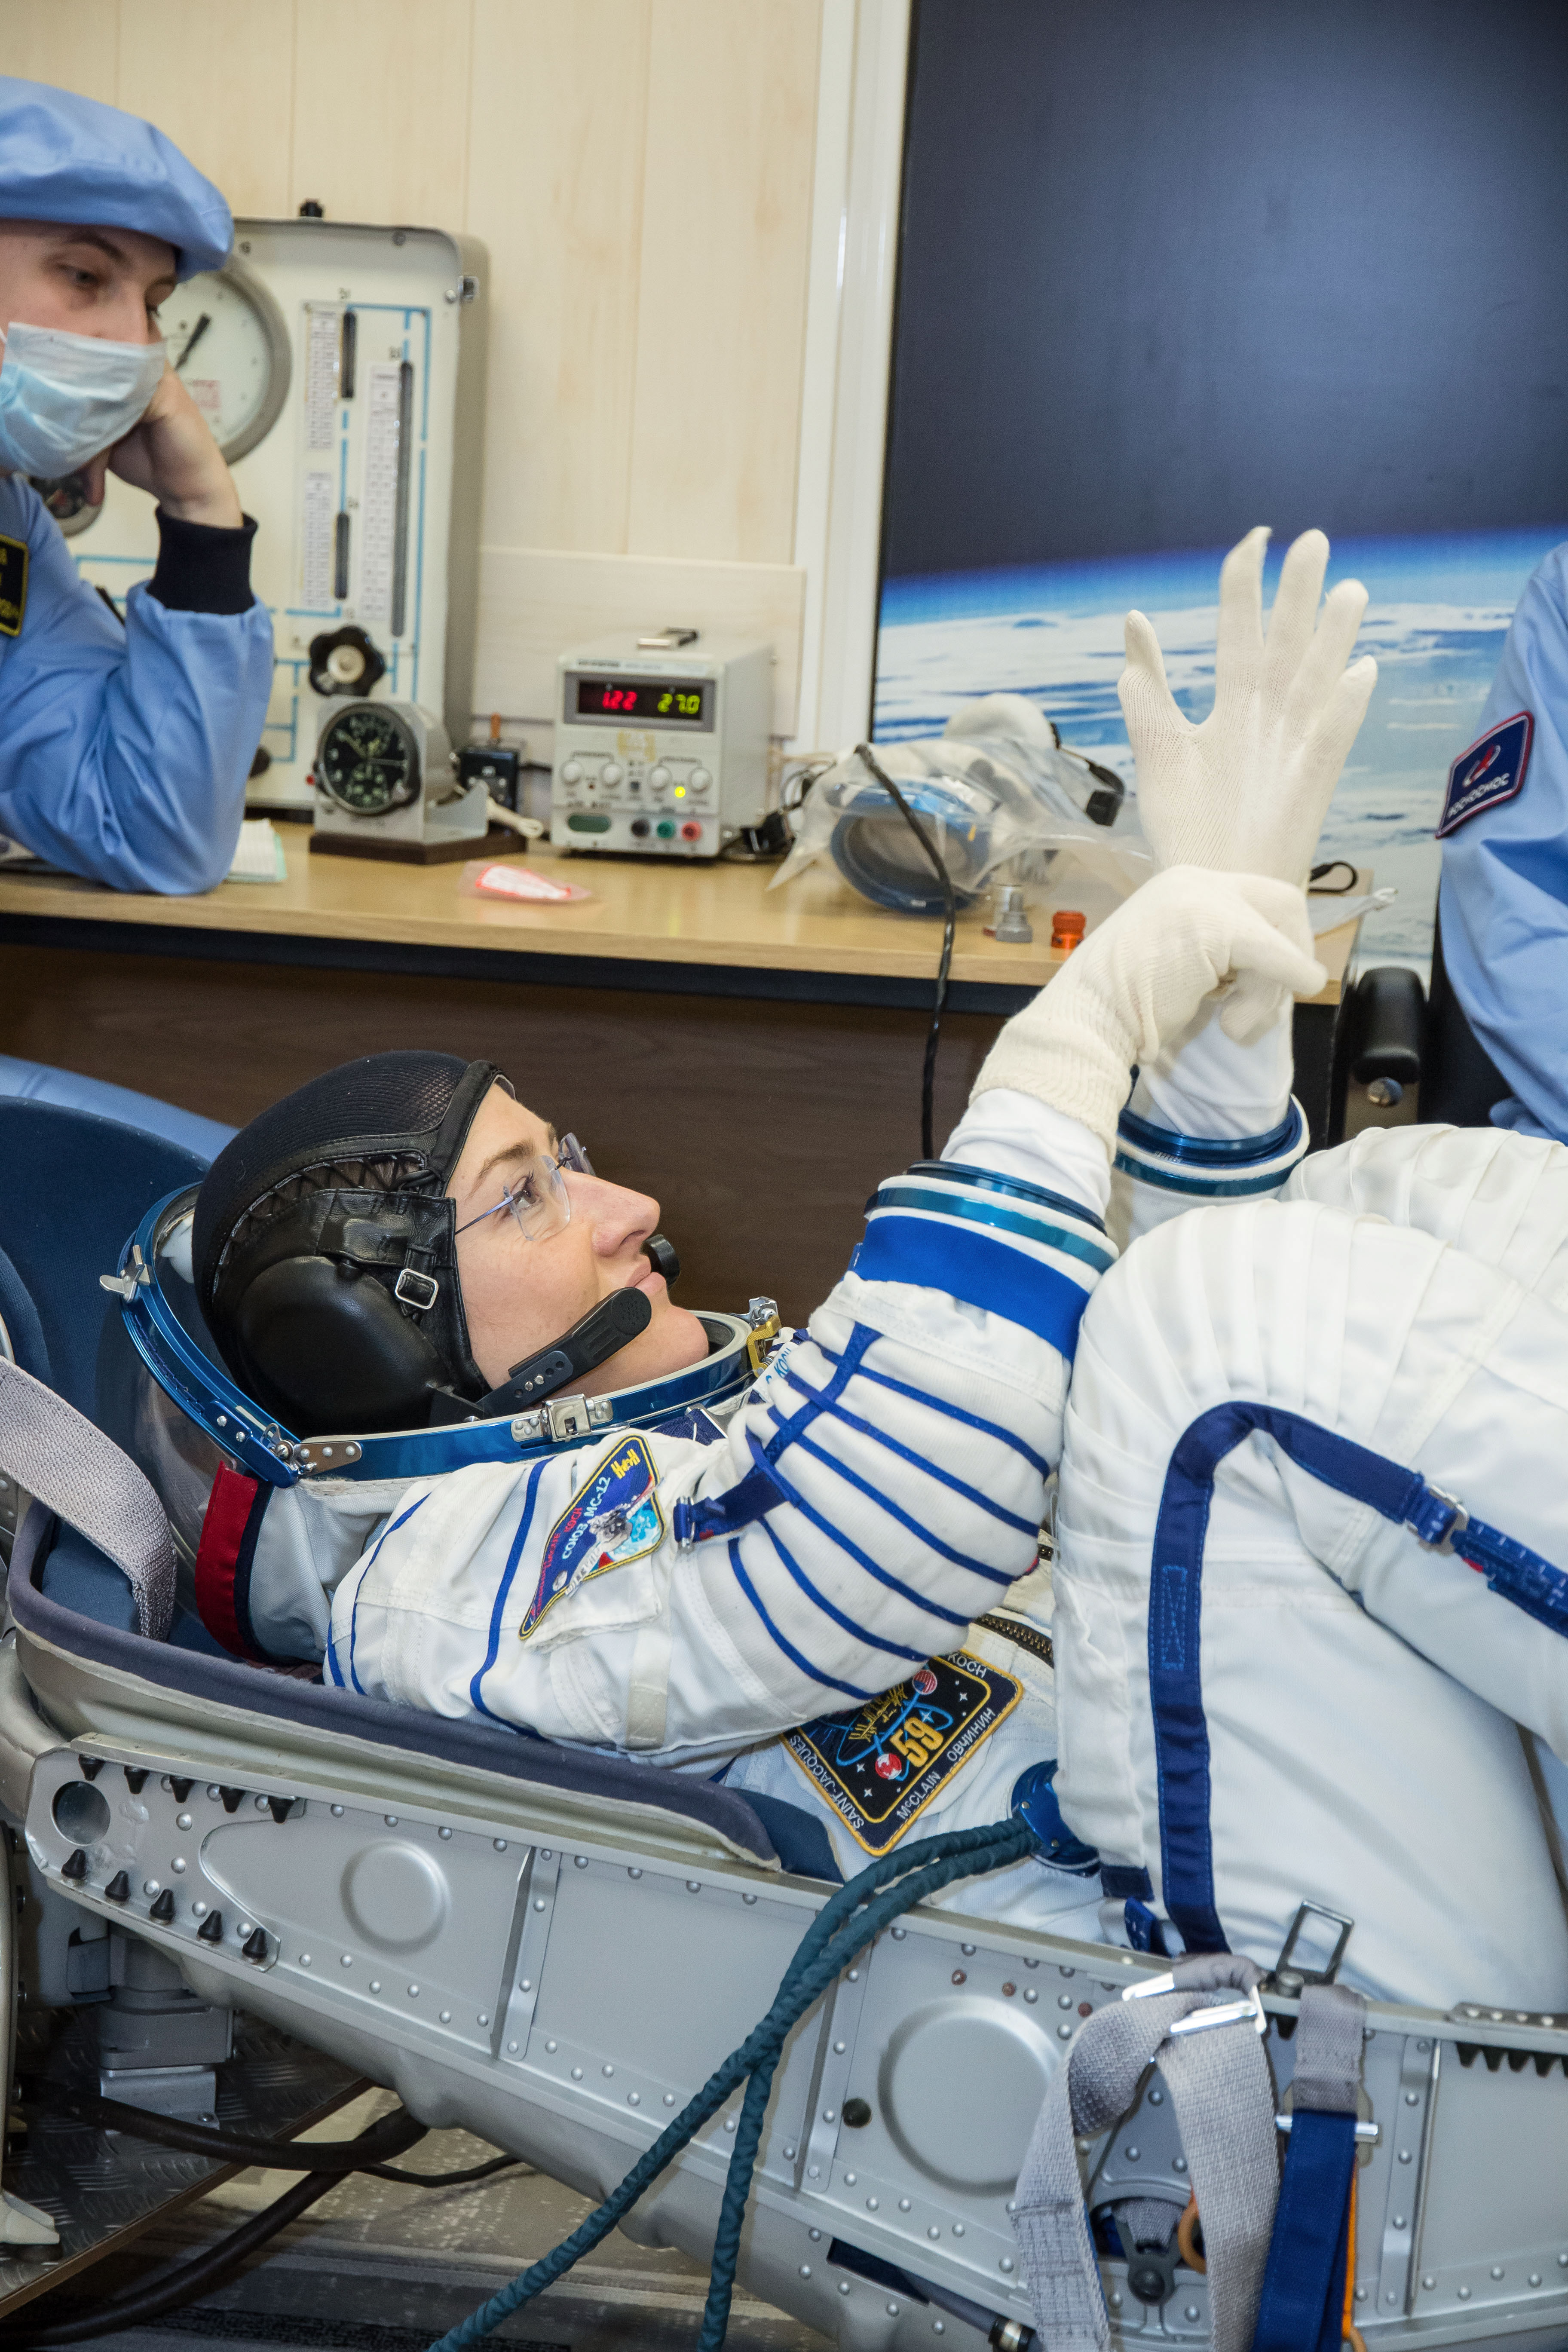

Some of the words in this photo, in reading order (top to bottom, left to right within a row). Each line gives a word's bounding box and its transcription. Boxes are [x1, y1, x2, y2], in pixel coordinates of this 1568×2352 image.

[561, 1523, 588, 1560] СОЮЗ
[584, 1476, 611, 1518] МС-12
[564, 1507, 583, 1532] KOCH
[947, 1652, 987, 1678] KOCH
[890, 1716, 944, 1768] 59
[946, 1707, 996, 1762] ОВЧИНИН
[790, 1735, 864, 1829] SAINT-JACQUES
[896, 1770, 942, 1820] McCLAIN
